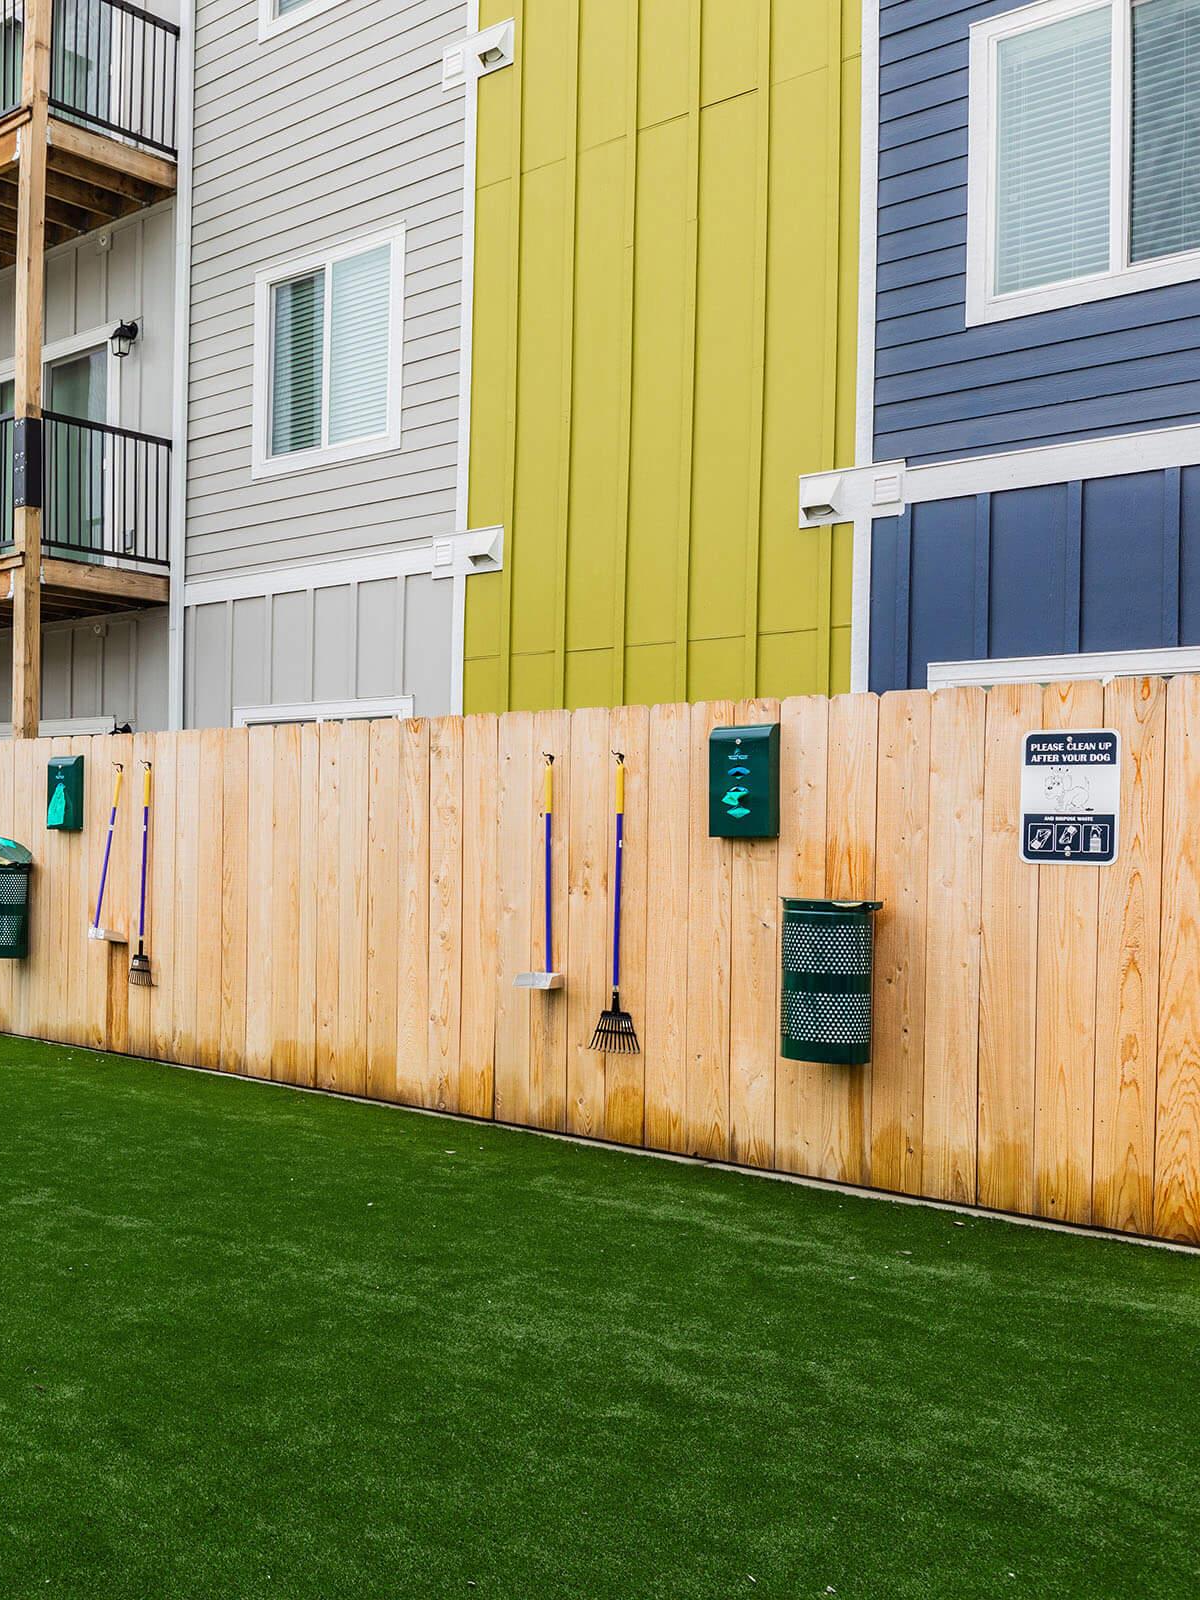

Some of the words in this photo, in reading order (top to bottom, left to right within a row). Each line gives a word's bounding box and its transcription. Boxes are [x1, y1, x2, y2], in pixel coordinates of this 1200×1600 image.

[1030, 743, 1064, 751] PLEASE
[1066, 742, 1096, 751] CLEAN
[1098, 742, 1112, 750] UP
[1031, 754, 1060, 762] AFTER
[1061, 754, 1087, 762] YOUR
[1089, 753, 1111, 762] DOG
